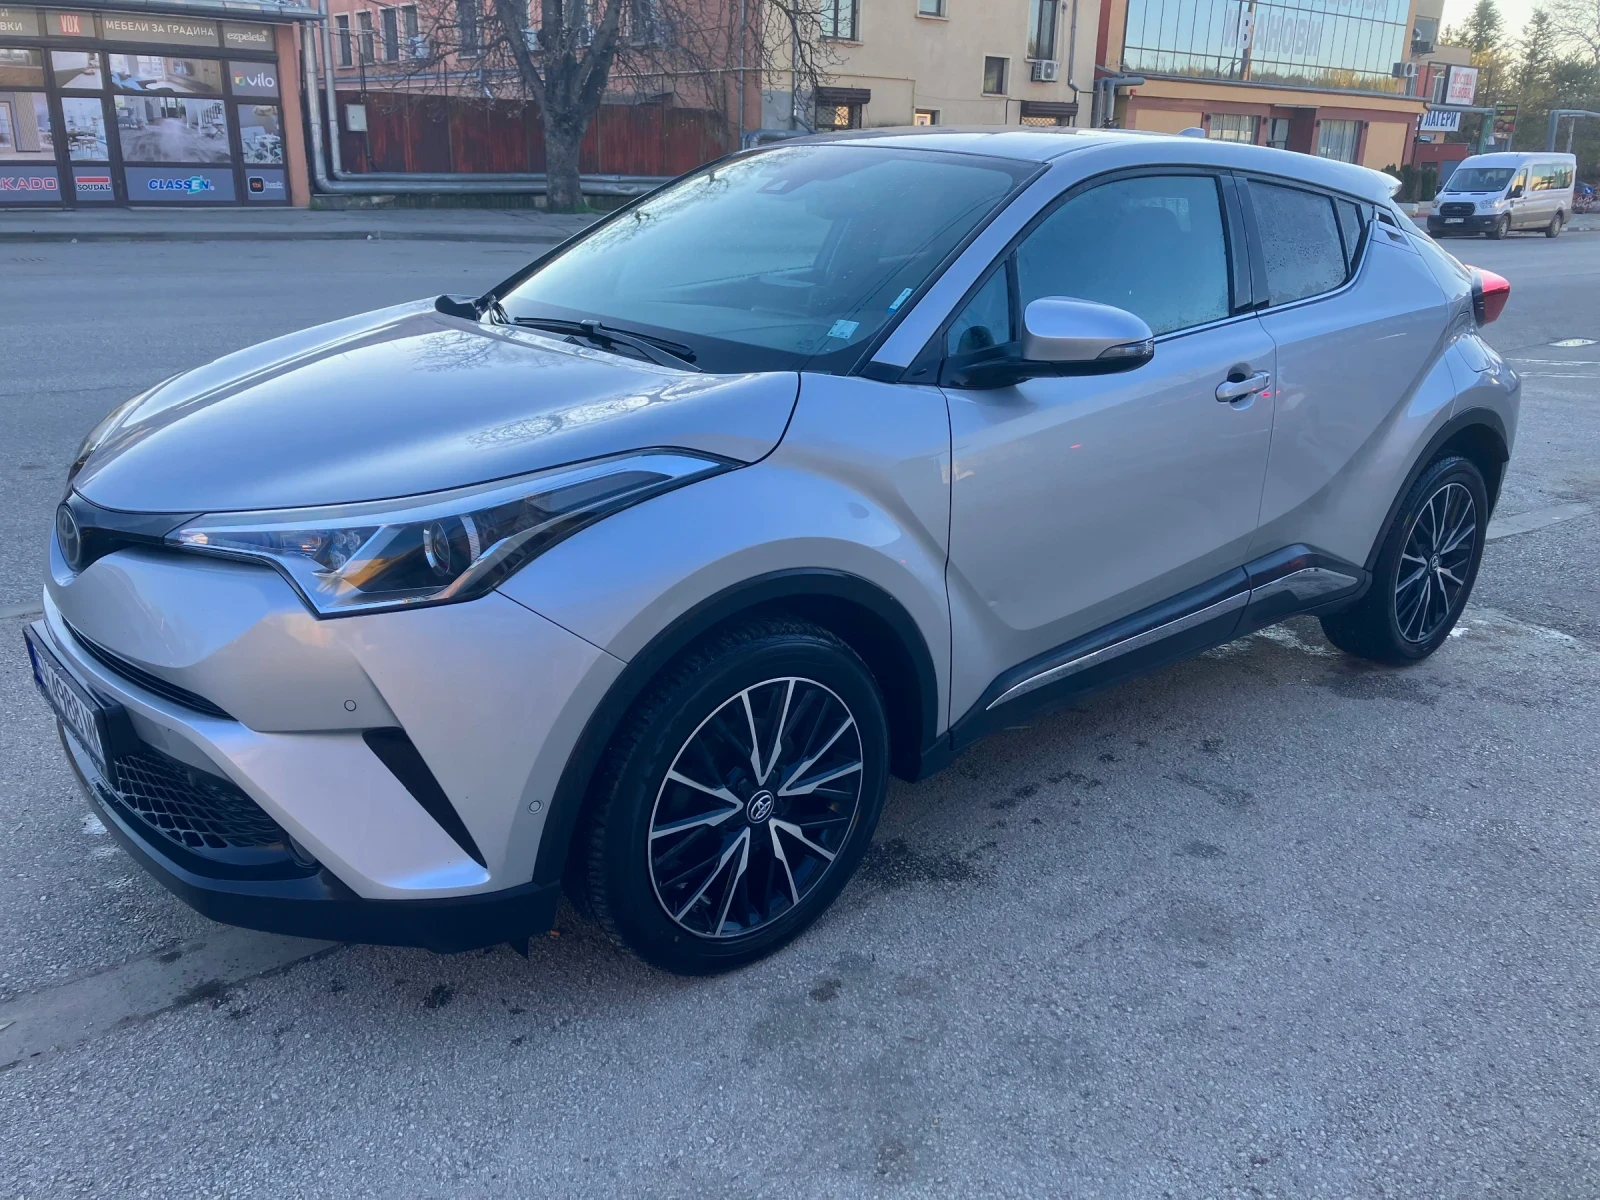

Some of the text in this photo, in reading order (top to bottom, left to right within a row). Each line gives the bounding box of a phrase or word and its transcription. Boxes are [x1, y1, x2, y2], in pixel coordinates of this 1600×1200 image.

[60, 14, 80, 33] VOX
[105, 20, 214, 37] МЕБЕЛИ ЗА ГРАДИНА
[226, 31, 266, 43] ezpeleta
[1223, 8, 1323, 57] ИВАНОВИ
[246, 71, 275, 88] vilo
[1424, 110, 1457, 127] ЛАГЕРИ
[0, 177, 58, 190] KADO
[148, 178, 210, 191] CLASSEN
